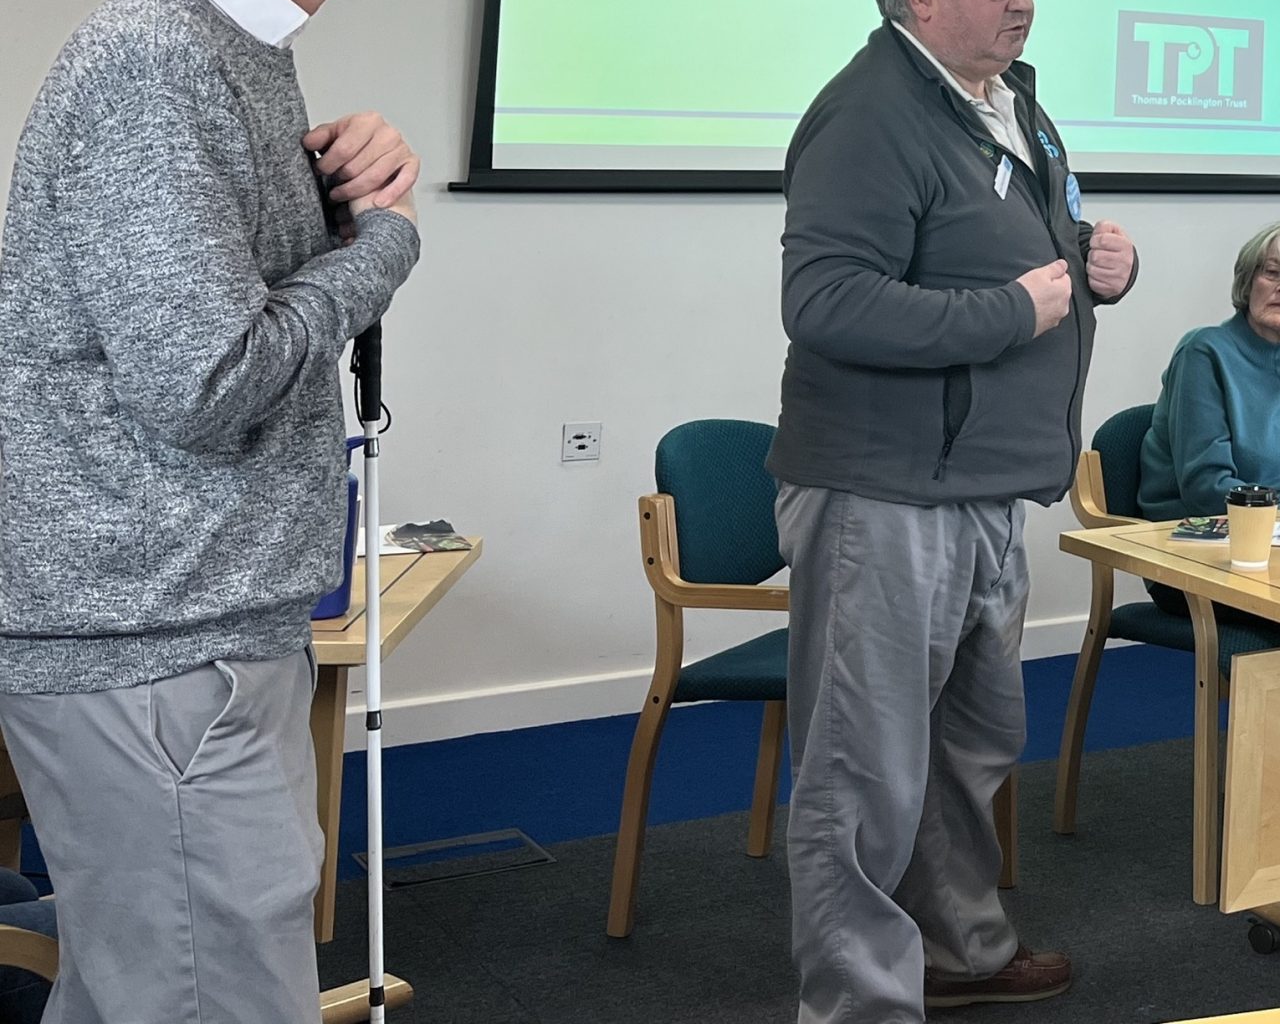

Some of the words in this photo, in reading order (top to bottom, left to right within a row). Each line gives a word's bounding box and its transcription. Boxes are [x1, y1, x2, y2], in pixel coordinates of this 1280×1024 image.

[1133, 21, 1250, 97] TPT
[1132, 94, 1168, 105] Thomas
[1170, 96, 1223, 108] Pocklington
[1225, 97, 1247, 108] Trust
